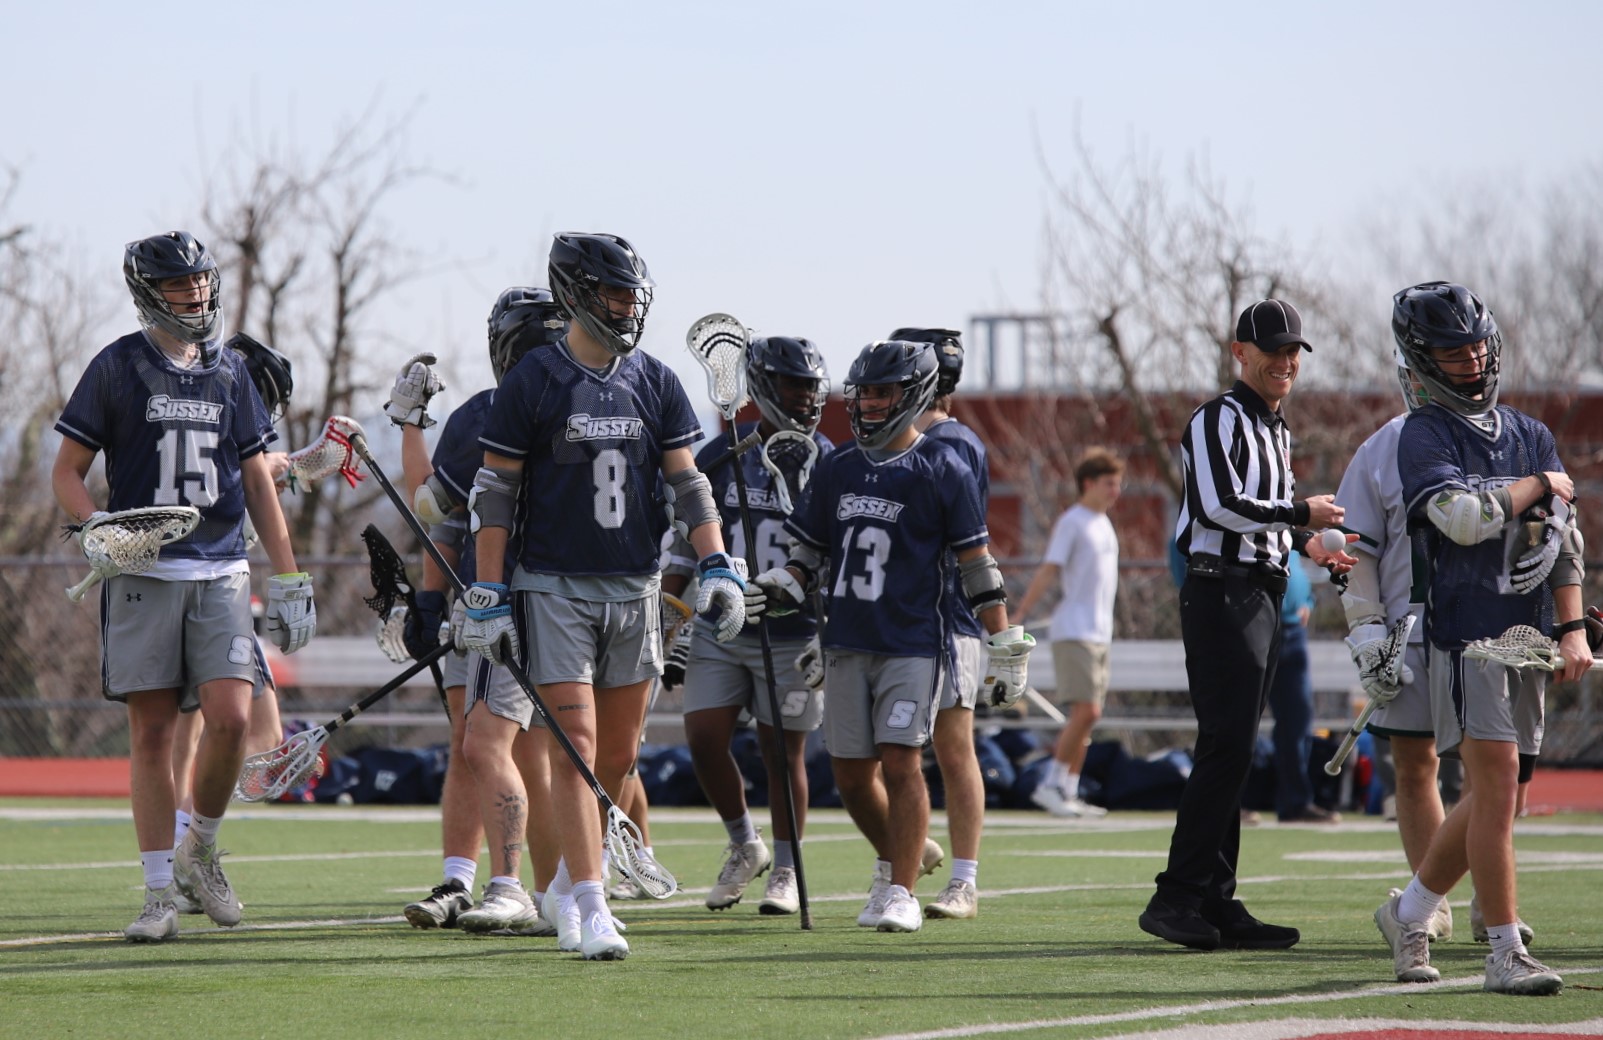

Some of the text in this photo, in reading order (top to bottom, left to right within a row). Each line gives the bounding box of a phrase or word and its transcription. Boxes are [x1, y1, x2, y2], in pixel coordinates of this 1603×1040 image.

[146, 394, 223, 424] SUSSEX
[566, 413, 643, 442] SUSSEX
[153, 429, 219, 507] 15
[593, 449, 627, 529] 8
[833, 525, 892, 602] 13
[227, 634, 253, 666] S
[780, 690, 810, 717] S
[886, 699, 919, 729] S
